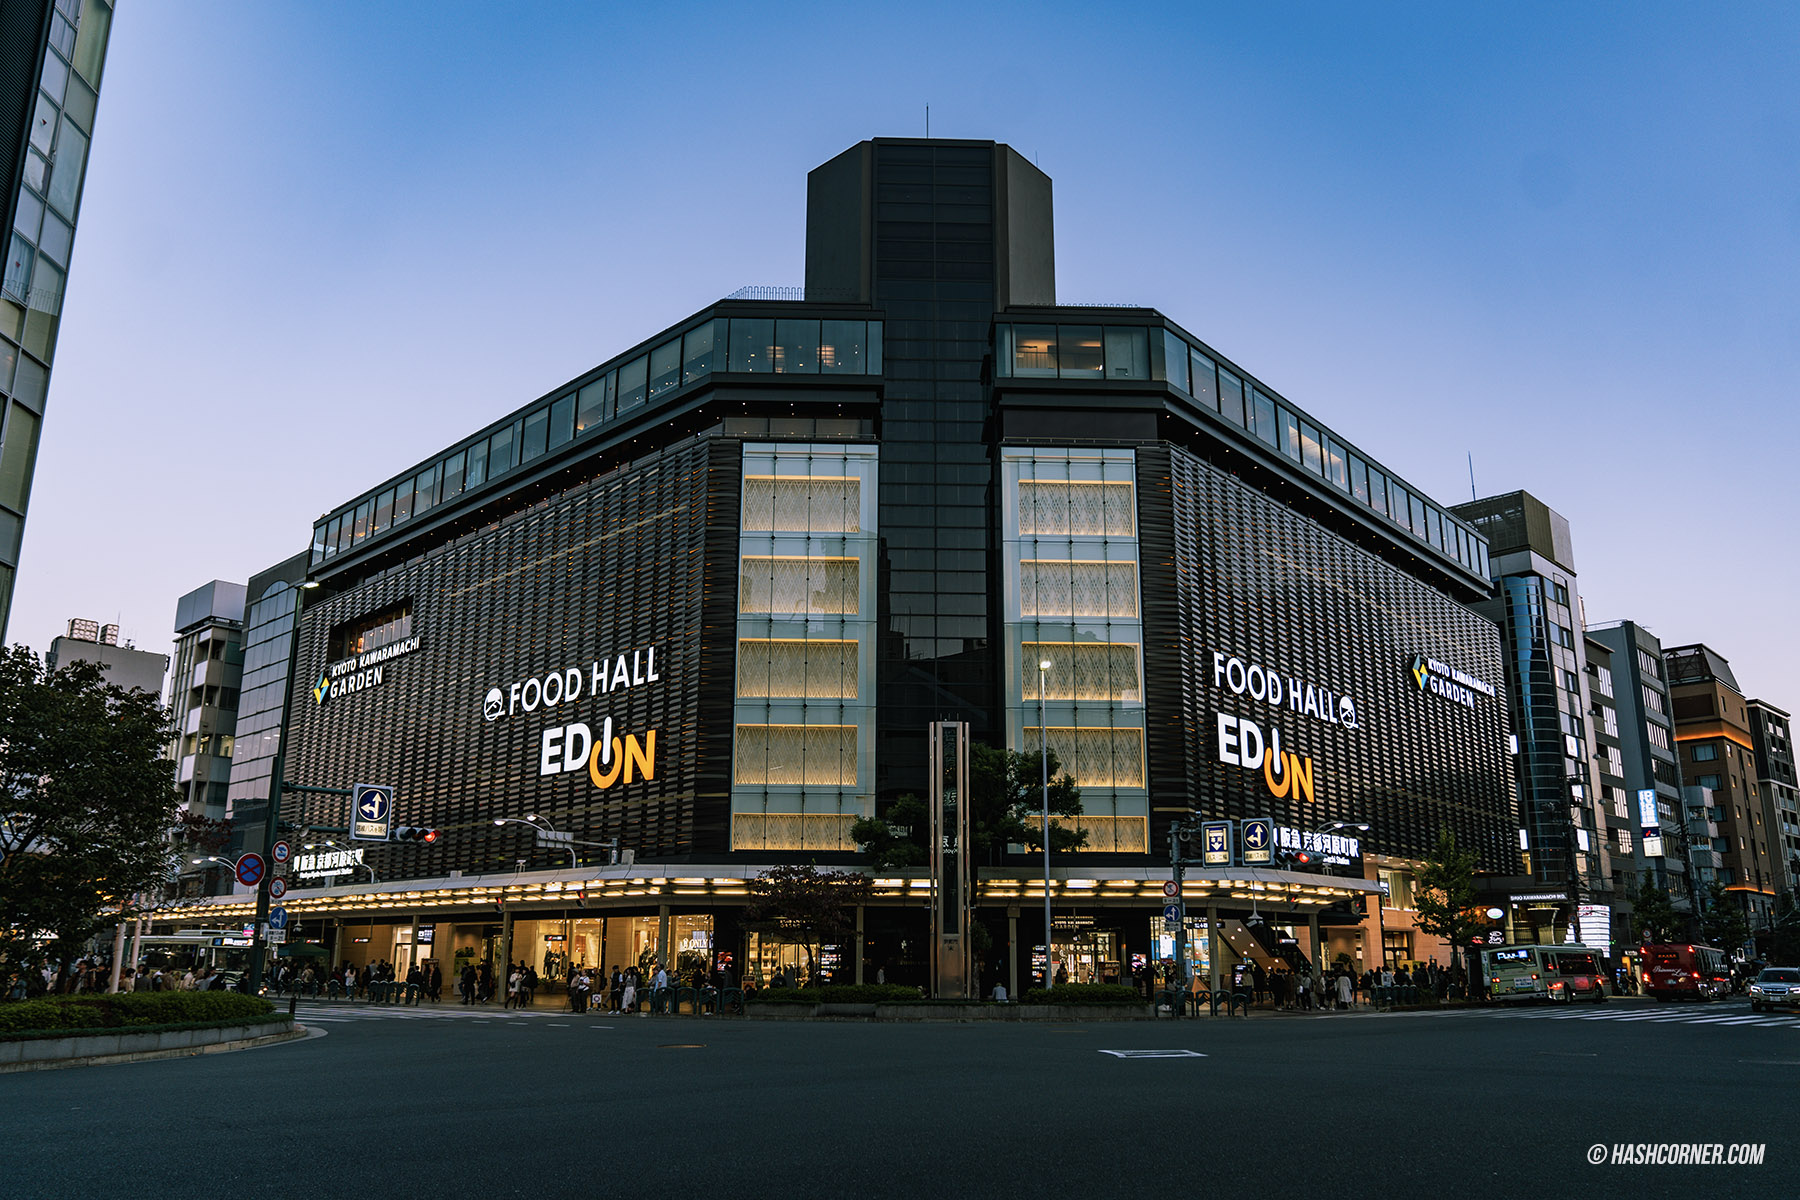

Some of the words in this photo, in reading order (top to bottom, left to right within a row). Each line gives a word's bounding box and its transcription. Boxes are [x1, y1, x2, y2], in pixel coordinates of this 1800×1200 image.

[332, 659, 357, 678] KYOTO
[359, 636, 420, 669] KAWARAMACHI
[1428, 657, 1450, 678] KYOTO
[330, 666, 383, 698] GARDEN
[509, 667, 582, 716] FOOD
[592, 646, 660, 696] HALL
[1213, 651, 1282, 706] FOOD
[1288, 678, 1338, 724] HALL
[1429, 677, 1475, 710] GARDEN
[540, 715, 656, 790] EDION
[1217, 712, 1315, 803] EDION
[1279, 826, 1302, 850] 阪急
[1302, 830, 1360, 858] 京都河原町駅
